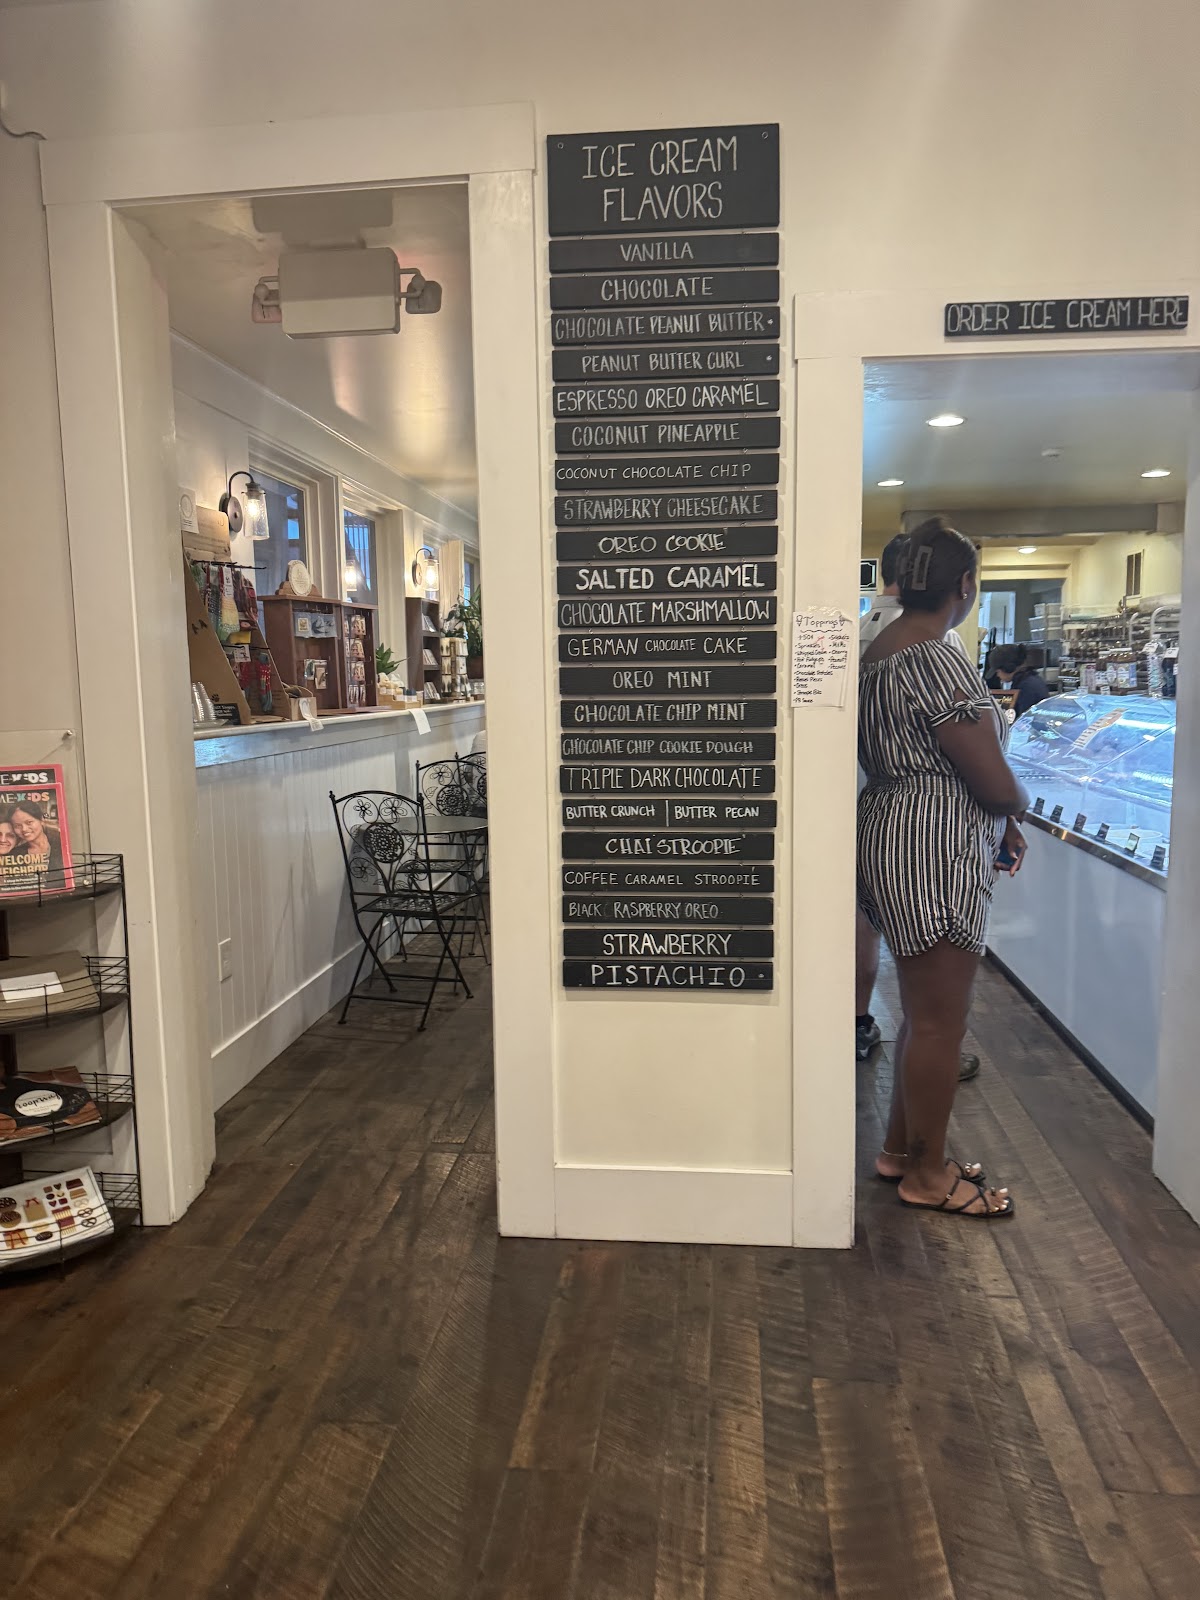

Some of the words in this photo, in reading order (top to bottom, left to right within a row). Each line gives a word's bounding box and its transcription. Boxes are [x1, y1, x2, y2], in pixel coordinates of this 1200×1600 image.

[582, 143, 635, 179] ICE
[650, 136, 737, 175] CREAM
[603, 181, 722, 221] FLAVORS
[620, 242, 694, 262] VANILLA
[601, 277, 713, 300] CHOCOLATE
[948, 304, 1009, 332] ORDER
[1018, 302, 1056, 330] ICE
[1066, 300, 1130, 328] CREAM
[1138, 298, 1188, 326] HERE
[555, 316, 645, 340] CHOCOLATE
[650, 313, 701, 334] PEANUT
[709, 312, 765, 332] BUTTER
[582, 354, 640, 373] PEANUT
[650, 352, 702, 370] BUTTER
[707, 352, 744, 369] CURL
[558, 389, 638, 411] ESPRESSO
[646, 387, 686, 408] OREO
[692, 383, 768, 406] CARAMEL
[572, 425, 648, 446] COCONUT
[658, 423, 740, 444] PINEAPPLE
[557, 467, 617, 480] COCONUT
[623, 465, 702, 479] CHOCOLATE
[710, 464, 751, 477] CHIP
[564, 498, 662, 520] STRAWBERRY
[667, 495, 763, 518] CHEESECAKE
[598, 536, 657, 554] OREO
[666, 534, 726, 552] COOKIE
[576, 568, 654, 590] SALTED
[668, 564, 764, 588] CARAMEL
[561, 602, 646, 626] CHOCOLATE
[652, 600, 770, 622] MARSHMALLOW
[803, 616, 838, 628] Toppings
[568, 638, 638, 656] GERMAN
[645, 639, 696, 652] CHOCOLATE
[704, 638, 748, 654] CAKE
[612, 671, 654, 688] OREO
[668, 671, 712, 688] MINT
[574, 704, 663, 722] CHOCOLATE
[666, 704, 701, 721] CHIP
[707, 702, 748, 720] MINT
[562, 738, 624, 755] CHOCOLATE
[627, 740, 654, 754] CHIP
[660, 740, 702, 754] COOKIE
[706, 741, 753, 754] DOUGH
[565, 768, 624, 790] TRIPLE
[630, 768, 670, 788] DARK
[675, 768, 762, 788] CHOCOLATE
[566, 806, 607, 818] BUTTER
[610, 805, 655, 817] CRUNCH
[675, 806, 717, 819] BUTTER
[725, 807, 759, 818] PECAN
[606, 838, 653, 854] CHAI
[656, 838, 742, 855] STROOPIE
[565, 872, 618, 885] COFFEE
[625, 874, 683, 885] CARAMEL
[695, 873, 760, 886] STROOPIE
[569, 902, 602, 916] BLACK
[614, 902, 681, 918] RASPBERRY
[685, 902, 718, 919] OREO
[603, 933, 732, 955] STRAWBERRY
[592, 965, 745, 987] PISTACHIO
